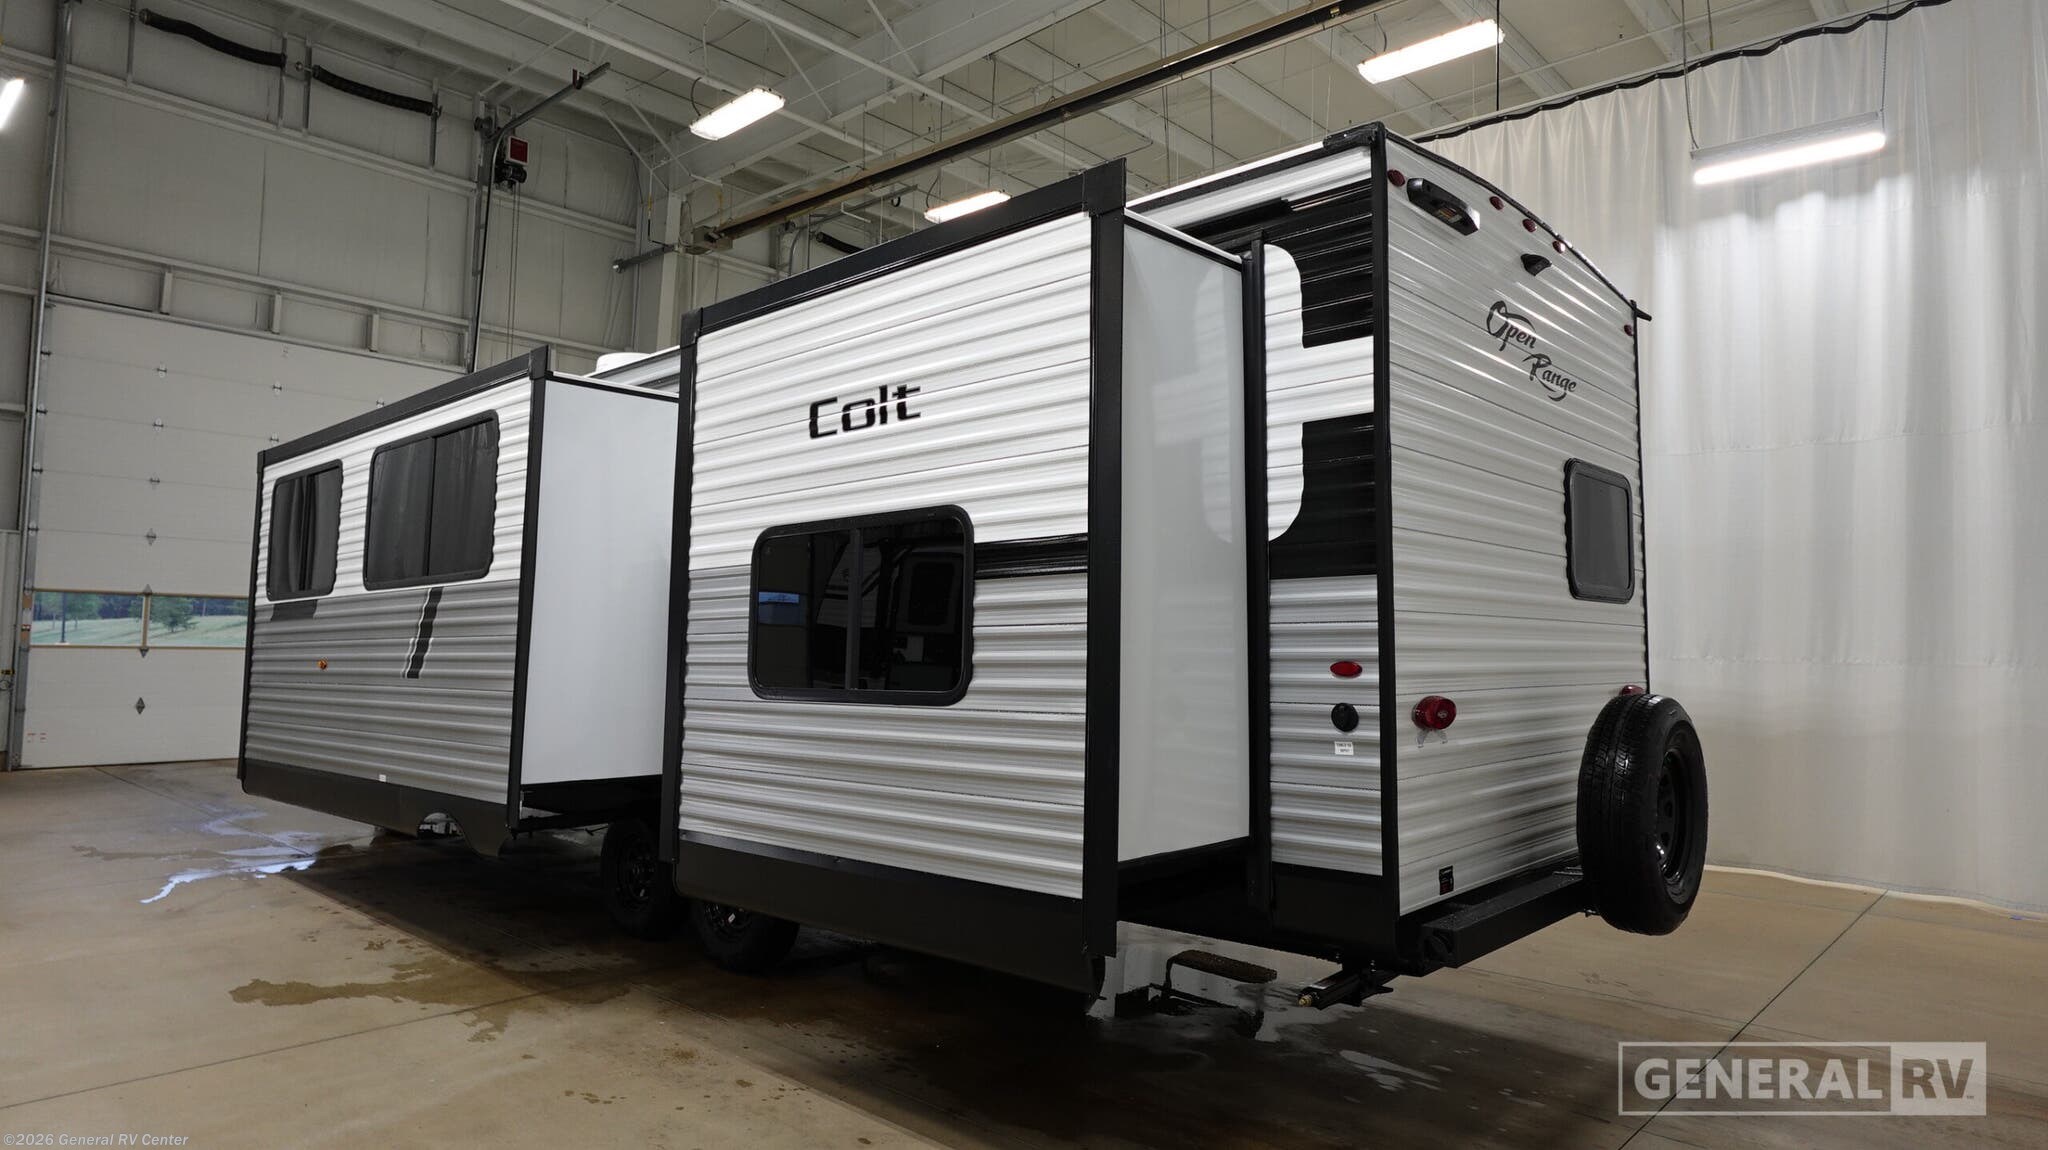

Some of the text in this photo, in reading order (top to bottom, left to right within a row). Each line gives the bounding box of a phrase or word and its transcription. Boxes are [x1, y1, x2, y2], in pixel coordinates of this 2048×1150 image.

[1486, 300, 1537, 352] Open
[1522, 353, 1577, 402] Range
[809, 384, 921, 439] Colt
